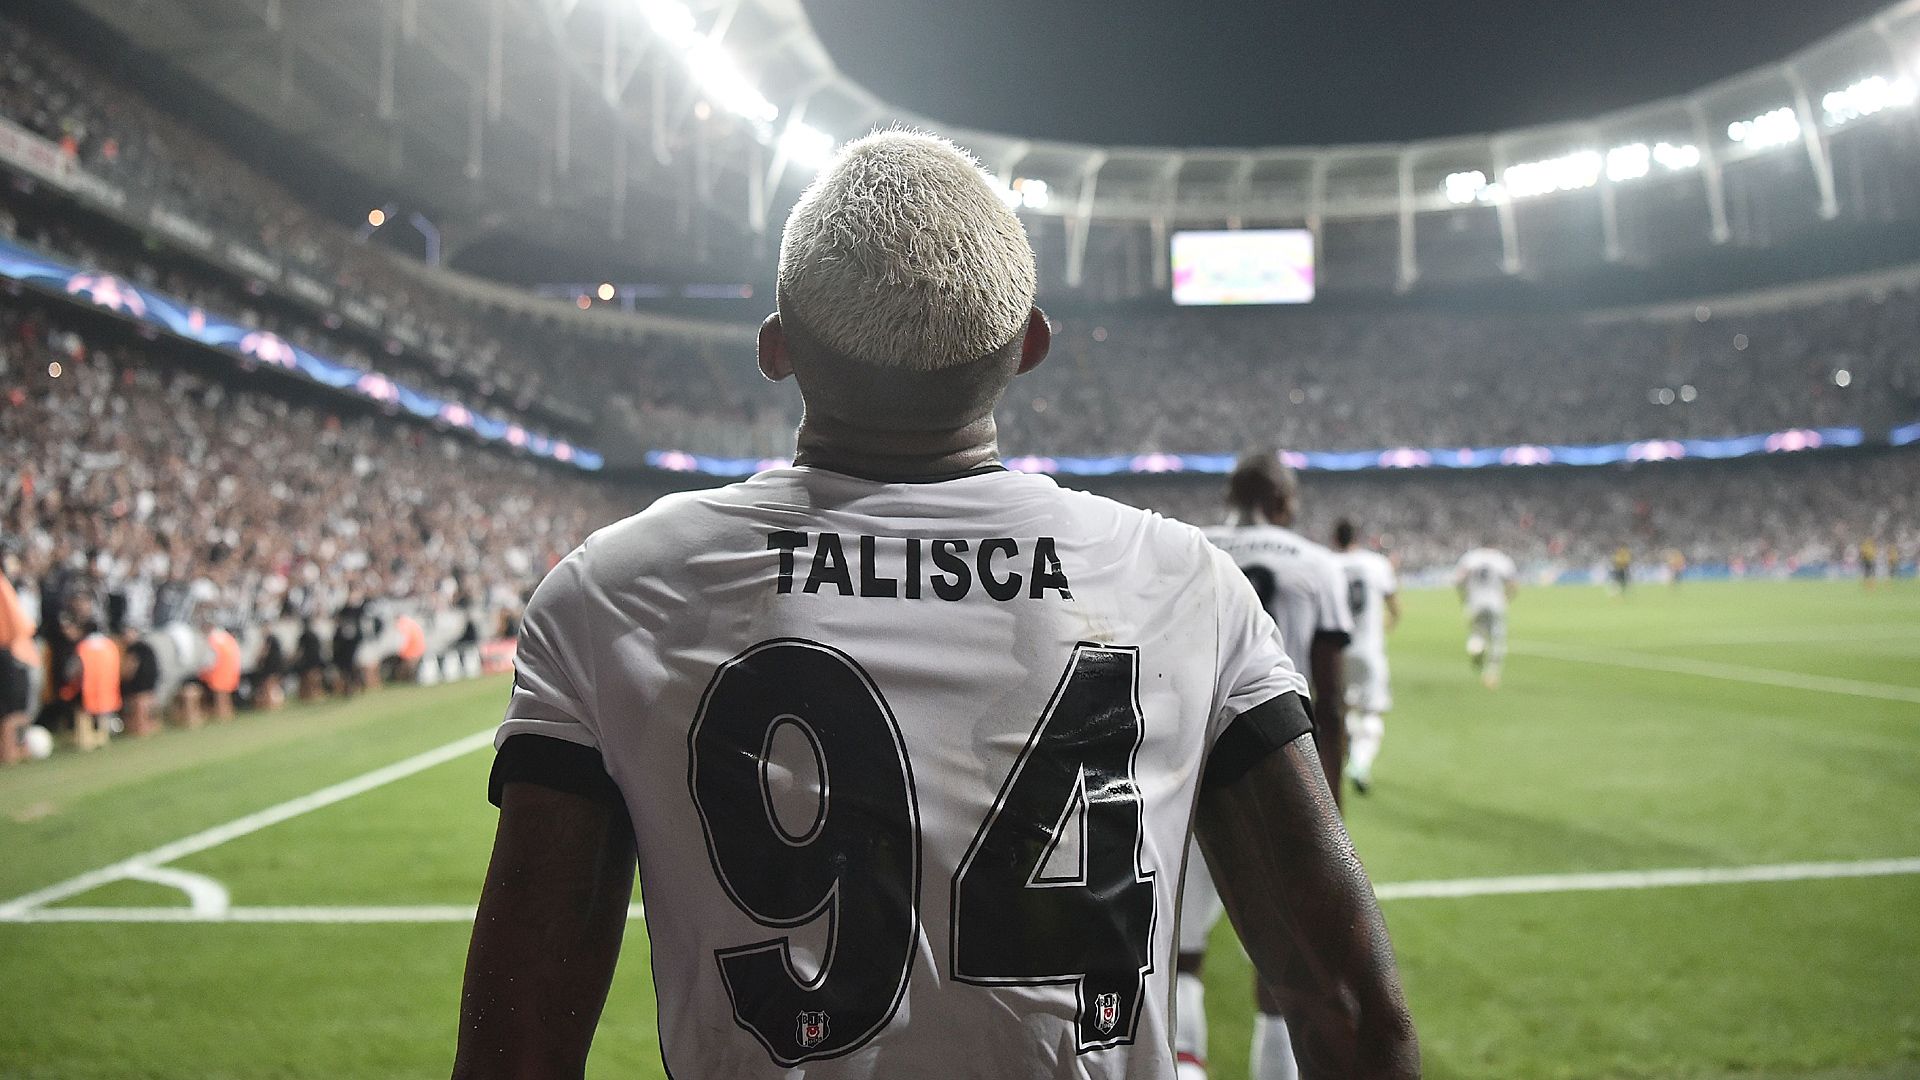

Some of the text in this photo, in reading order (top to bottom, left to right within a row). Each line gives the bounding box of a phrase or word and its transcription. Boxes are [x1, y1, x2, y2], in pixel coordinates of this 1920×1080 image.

[767, 531, 1074, 601] TALISCA
[688, 638, 1156, 1067] 94
[802, 1015, 823, 1024] BJK
